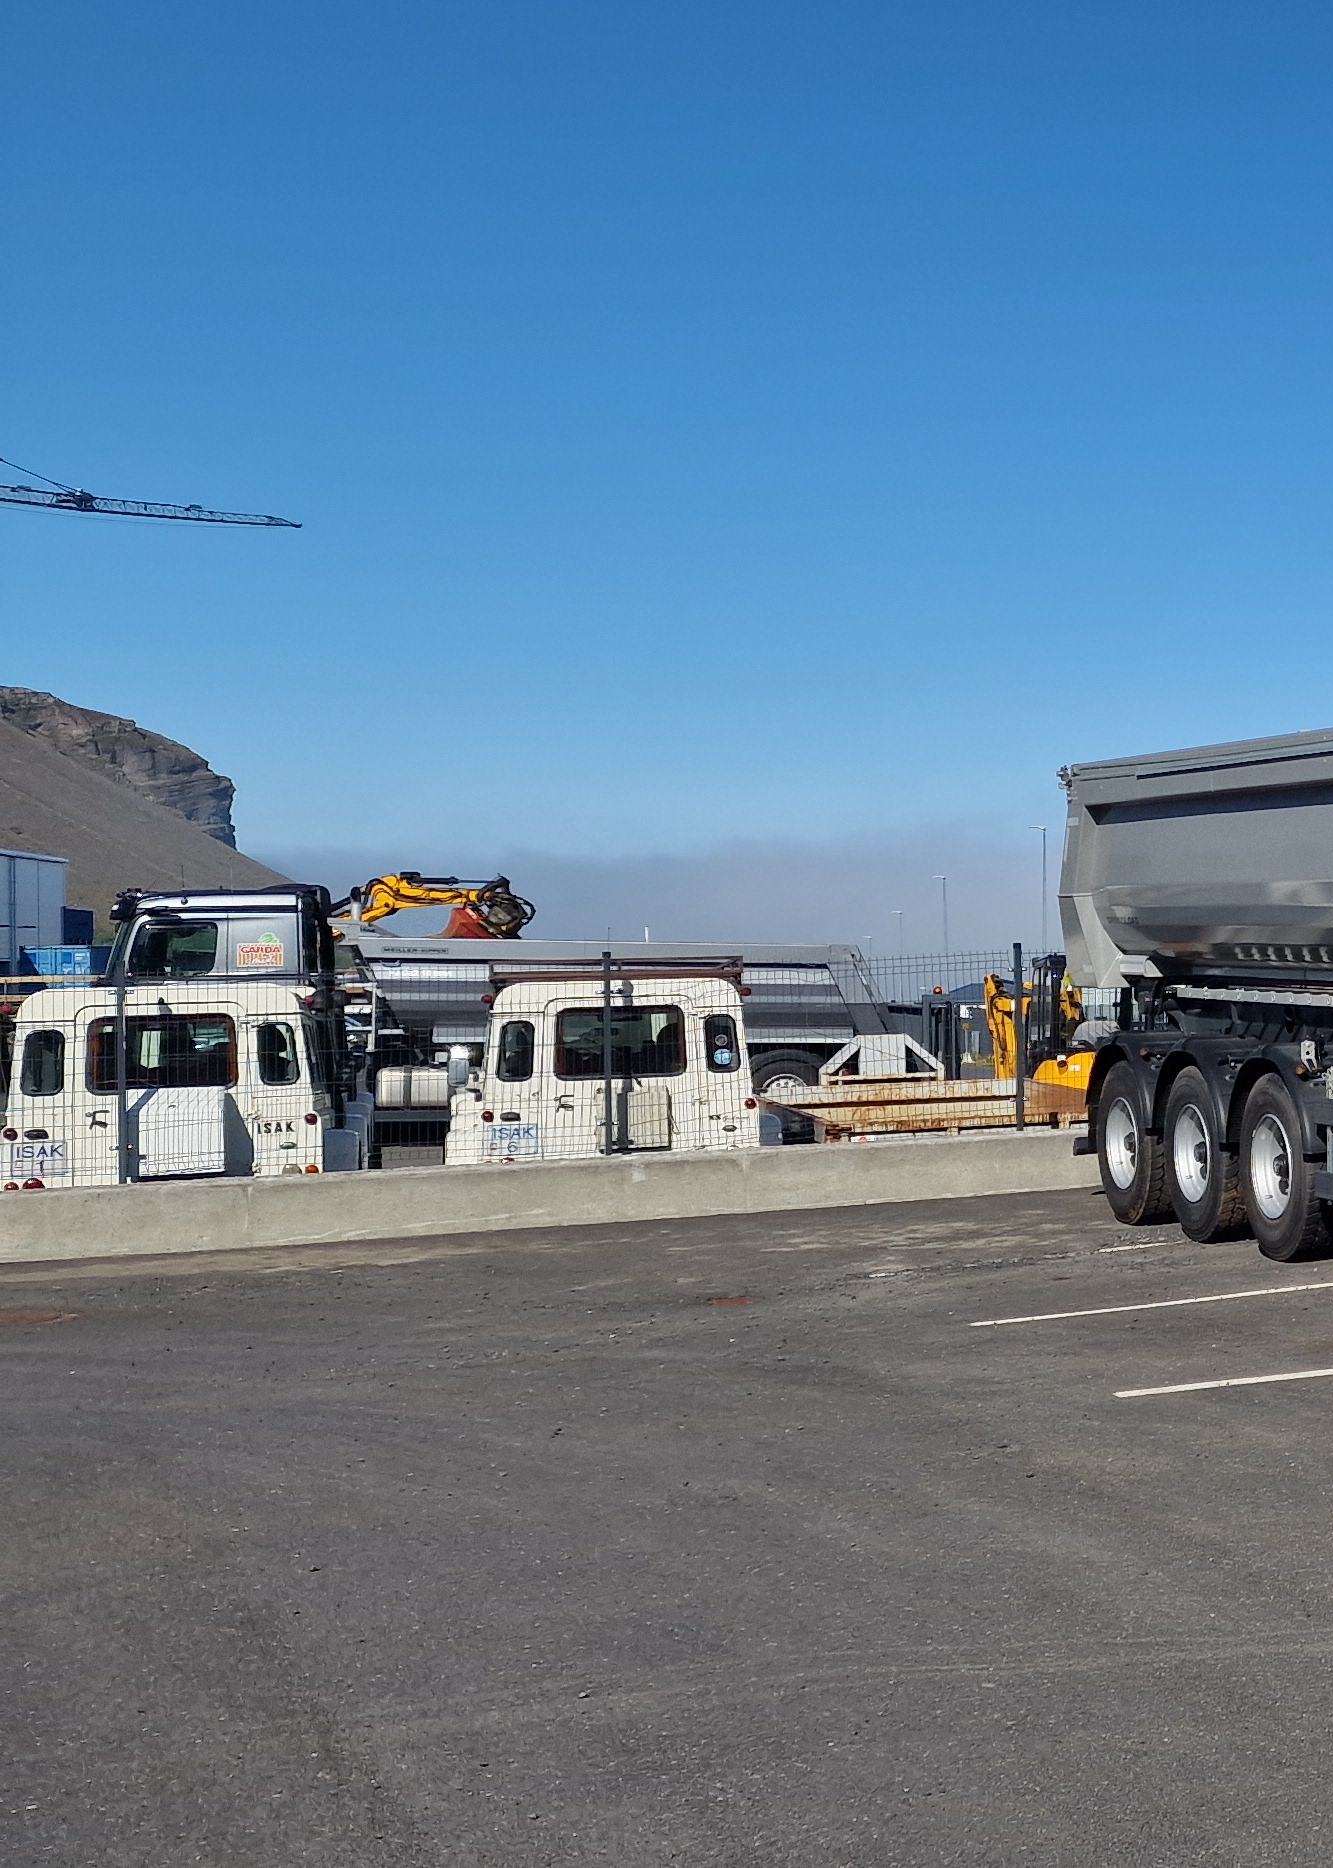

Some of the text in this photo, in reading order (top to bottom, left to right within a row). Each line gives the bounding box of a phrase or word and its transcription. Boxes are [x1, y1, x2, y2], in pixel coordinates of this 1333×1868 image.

[257, 1121, 296, 1135] ISAK
[492, 1127, 534, 1140] ISAK
[16, 1144, 64, 1159] ISAK
[507, 1141, 518, 1153] 6
[36, 1160, 45, 1174] 1
